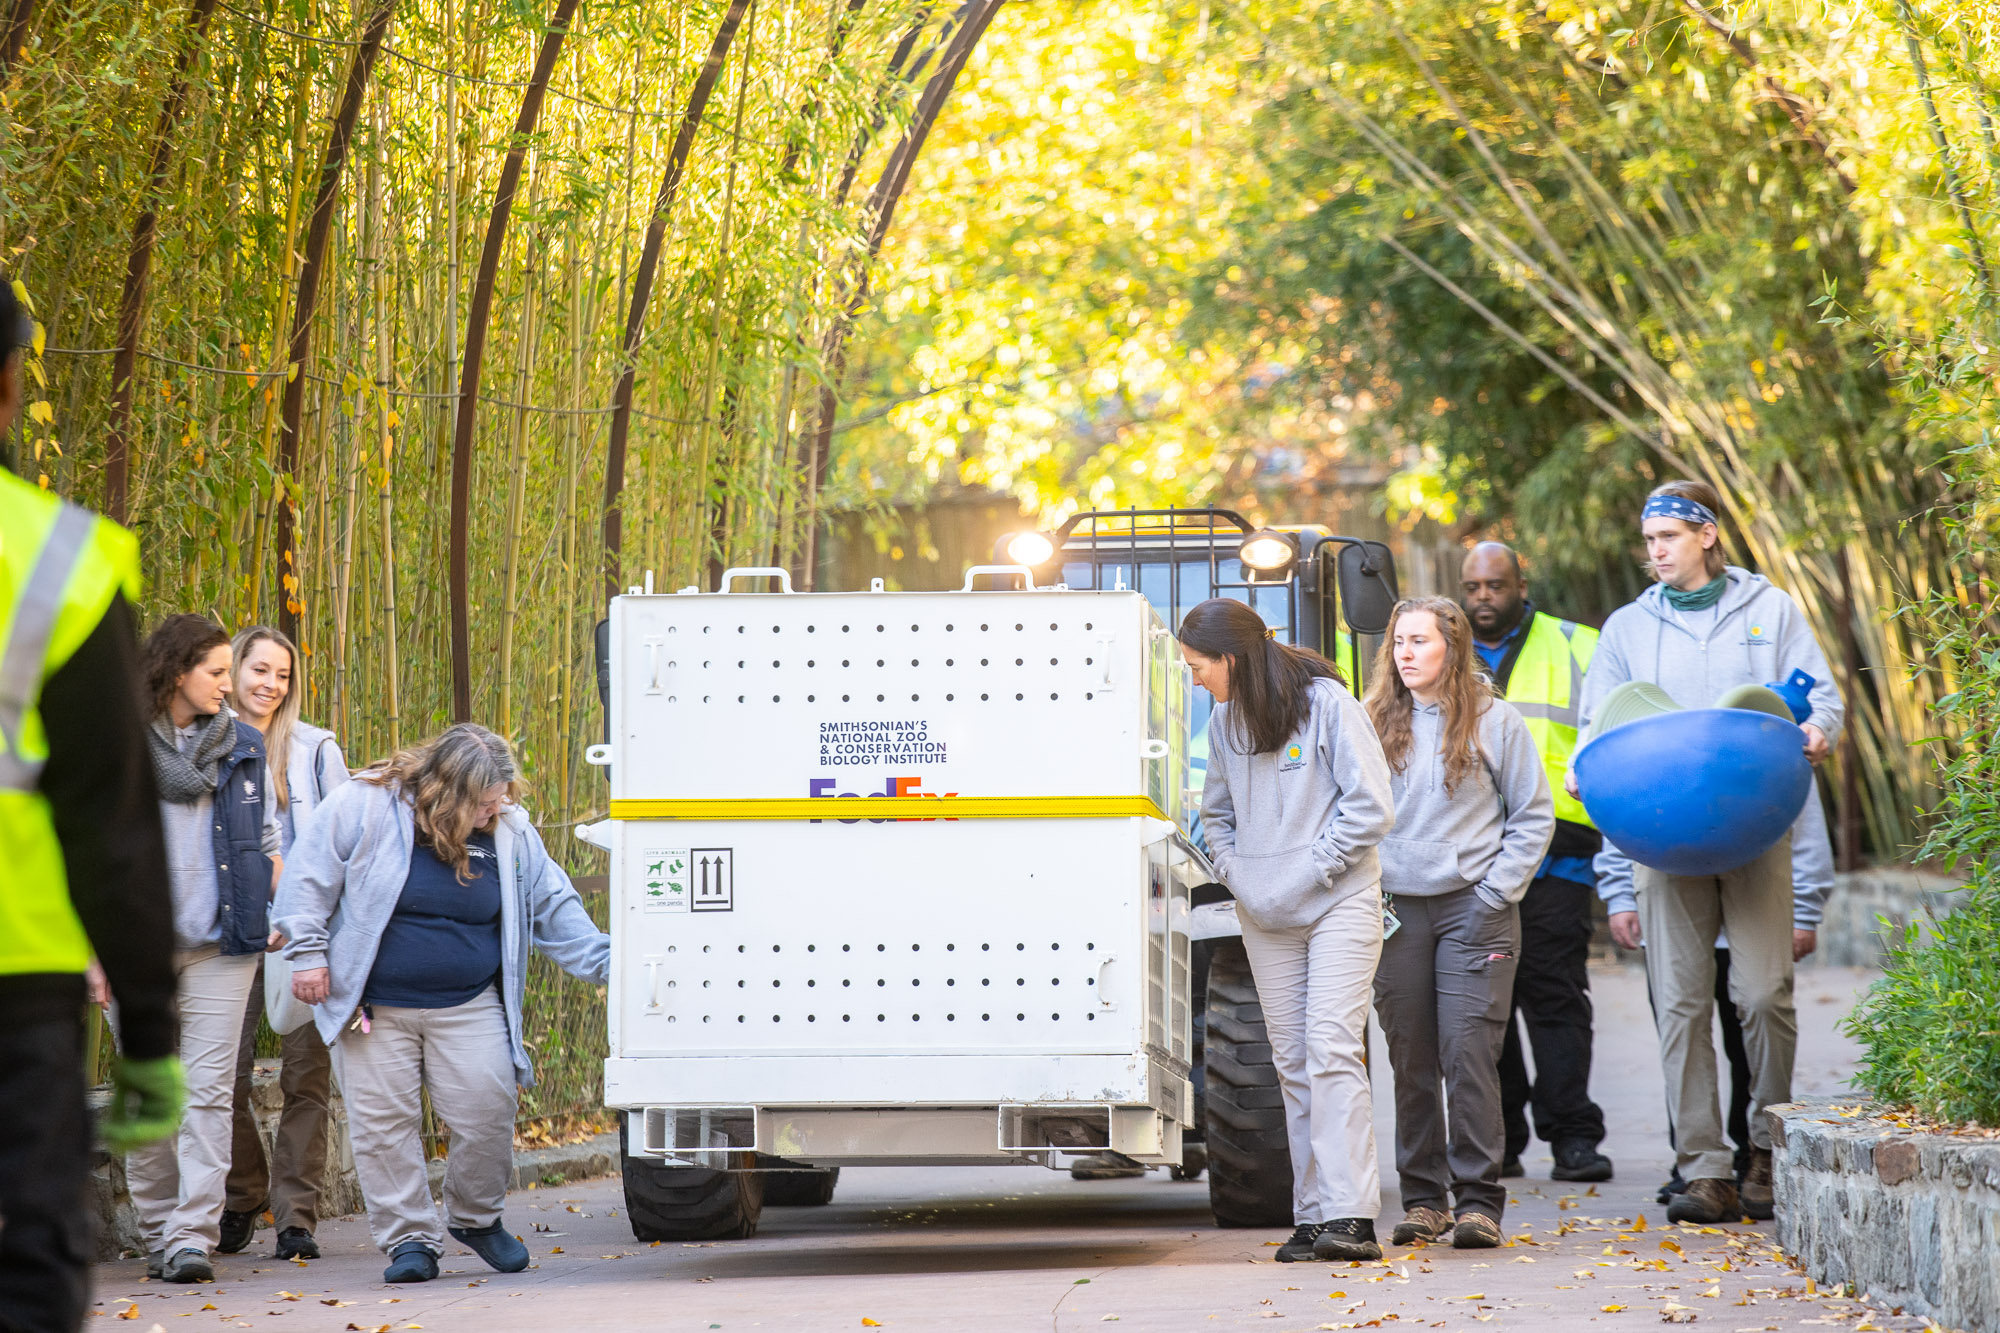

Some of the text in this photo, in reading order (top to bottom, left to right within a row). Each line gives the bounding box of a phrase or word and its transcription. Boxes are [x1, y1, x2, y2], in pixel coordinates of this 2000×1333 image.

[820, 720, 928, 733] SMITHSONIAN'S
[820, 731, 928, 743] NATIONAL ZOO
[820, 742, 947, 755] & CONSERVATION
[820, 753, 947, 766] BIOLOGY INSTITUTE
[809, 777, 960, 824] FdE
